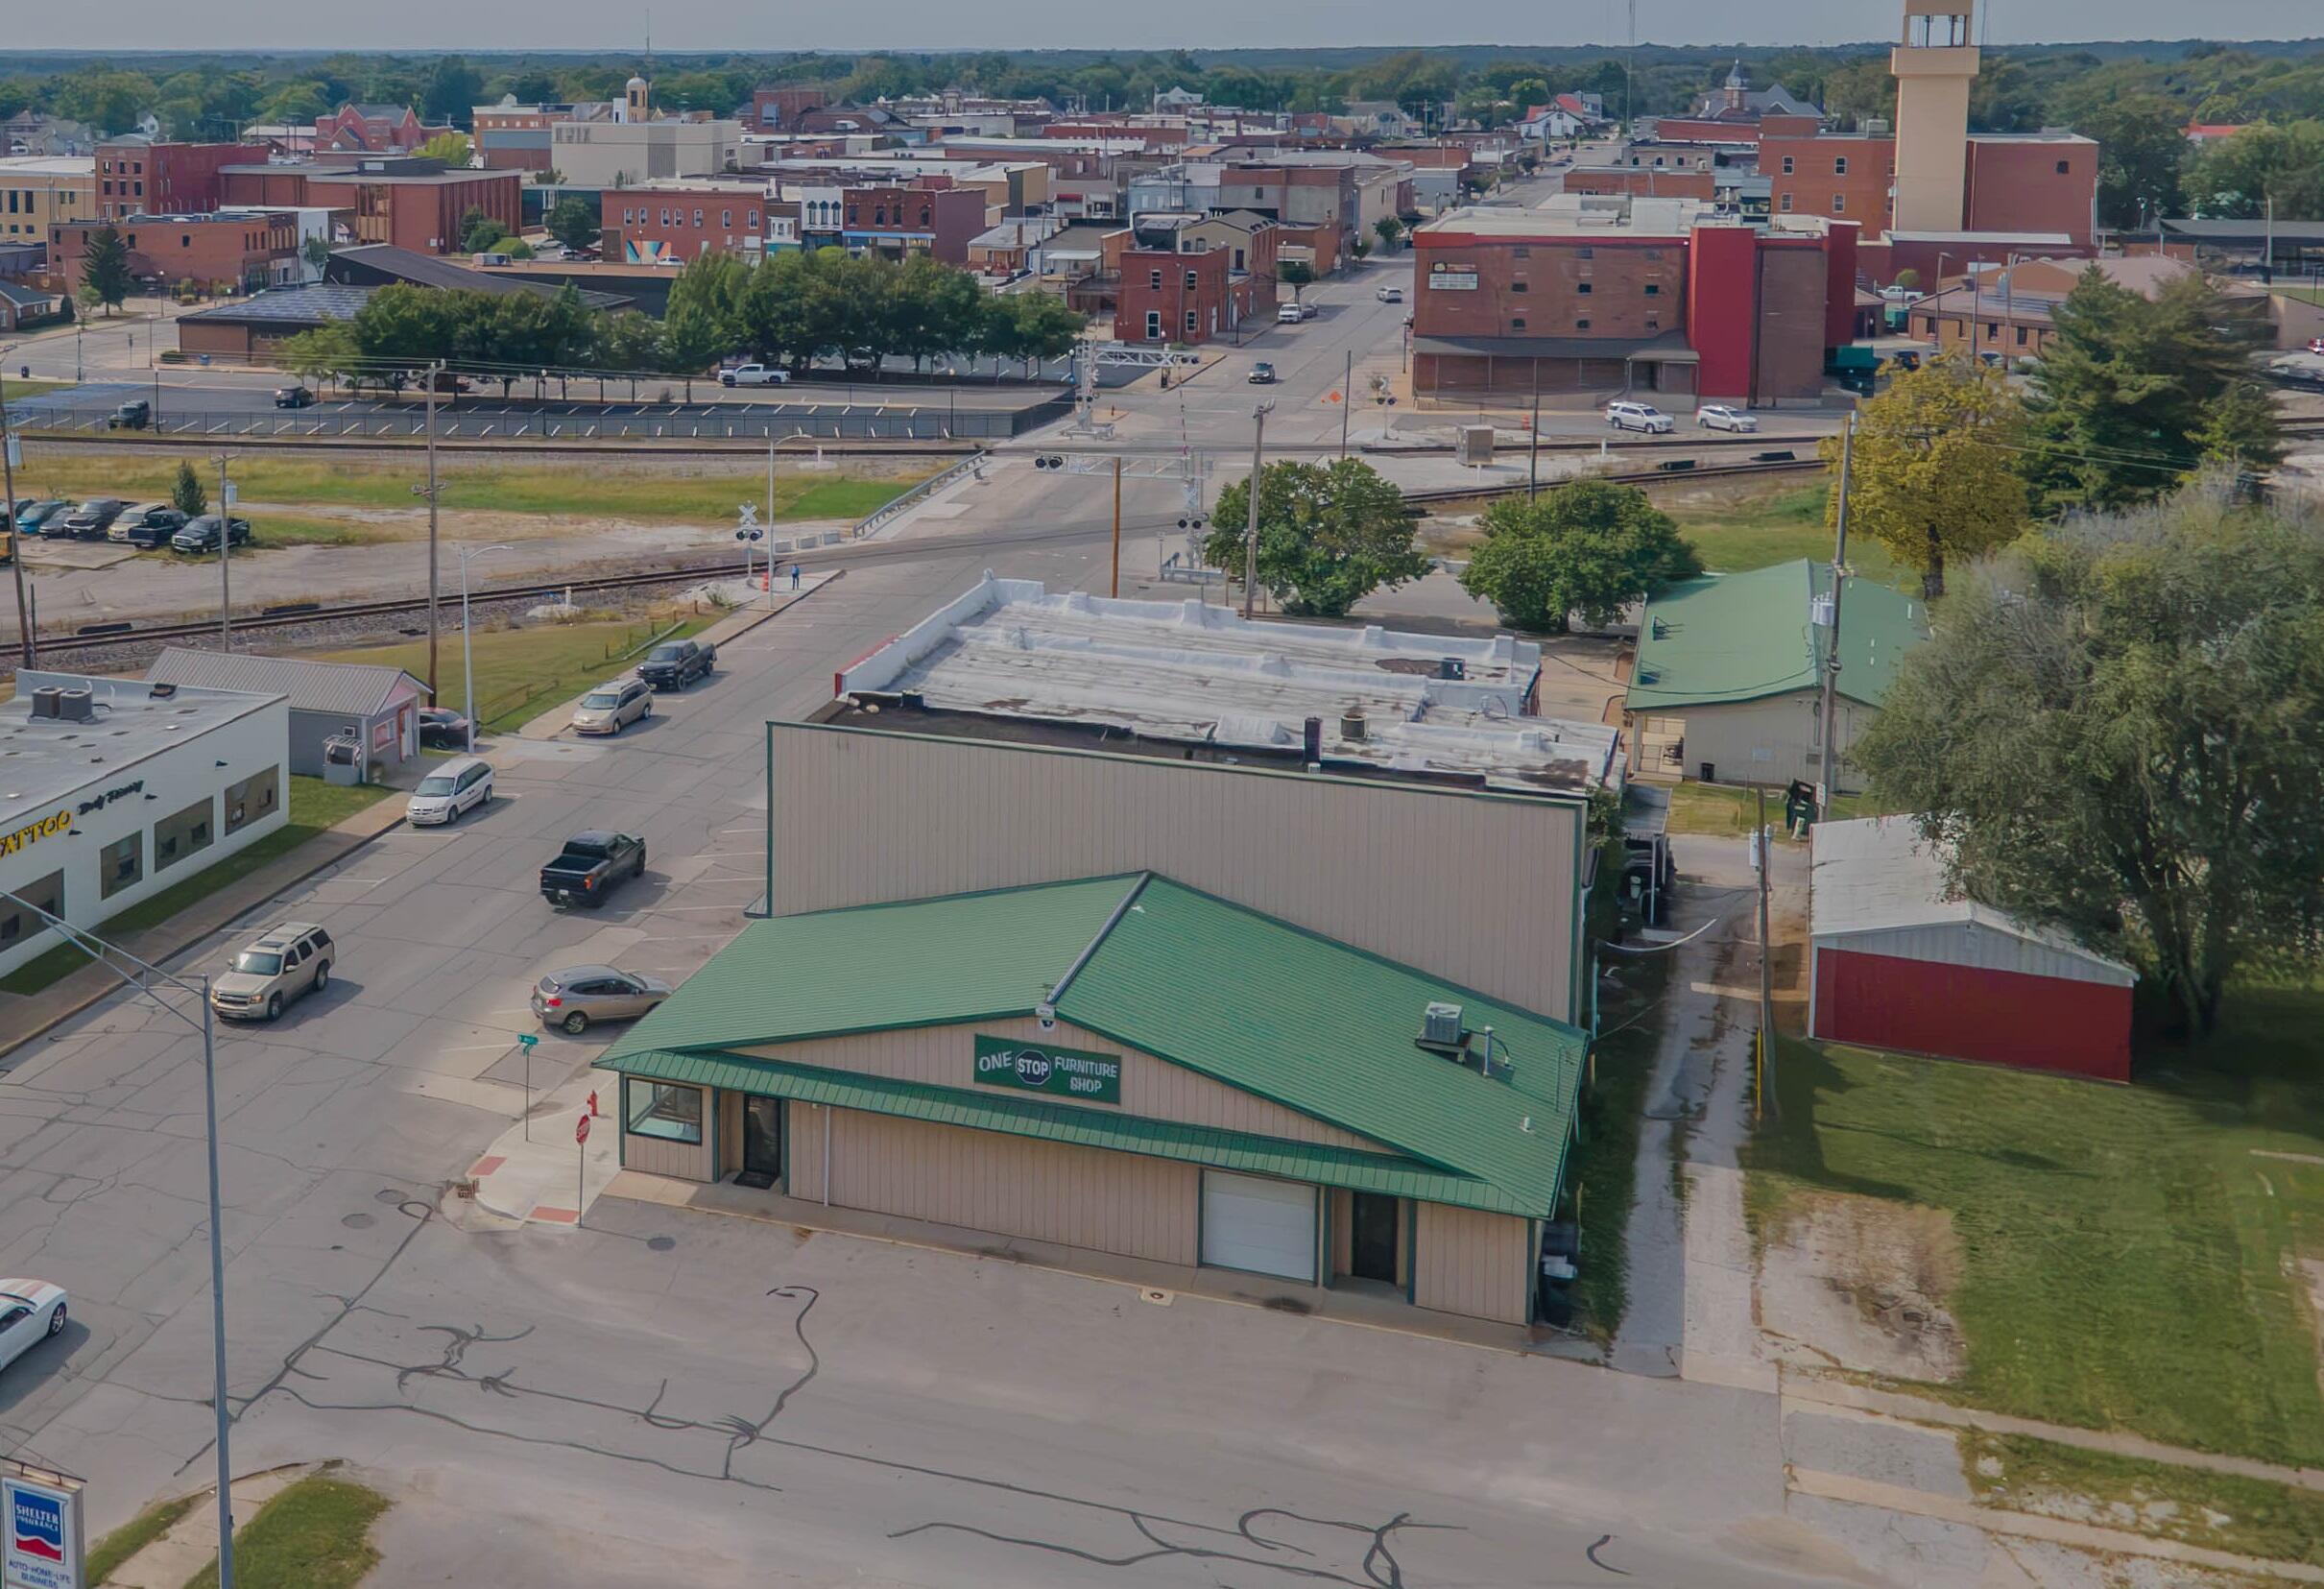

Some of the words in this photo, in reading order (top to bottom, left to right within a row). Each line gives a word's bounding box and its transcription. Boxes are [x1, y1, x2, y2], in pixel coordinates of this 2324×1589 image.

[0, 810, 70, 859] ATTOO
[979, 1051, 1013, 1071] ONE
[1018, 1058, 1049, 1076] STOP
[1055, 1056, 1117, 1078] FURNITURE
[1069, 1076, 1102, 1093] SHOP
[15, 1504, 59, 1525] SHELTER
